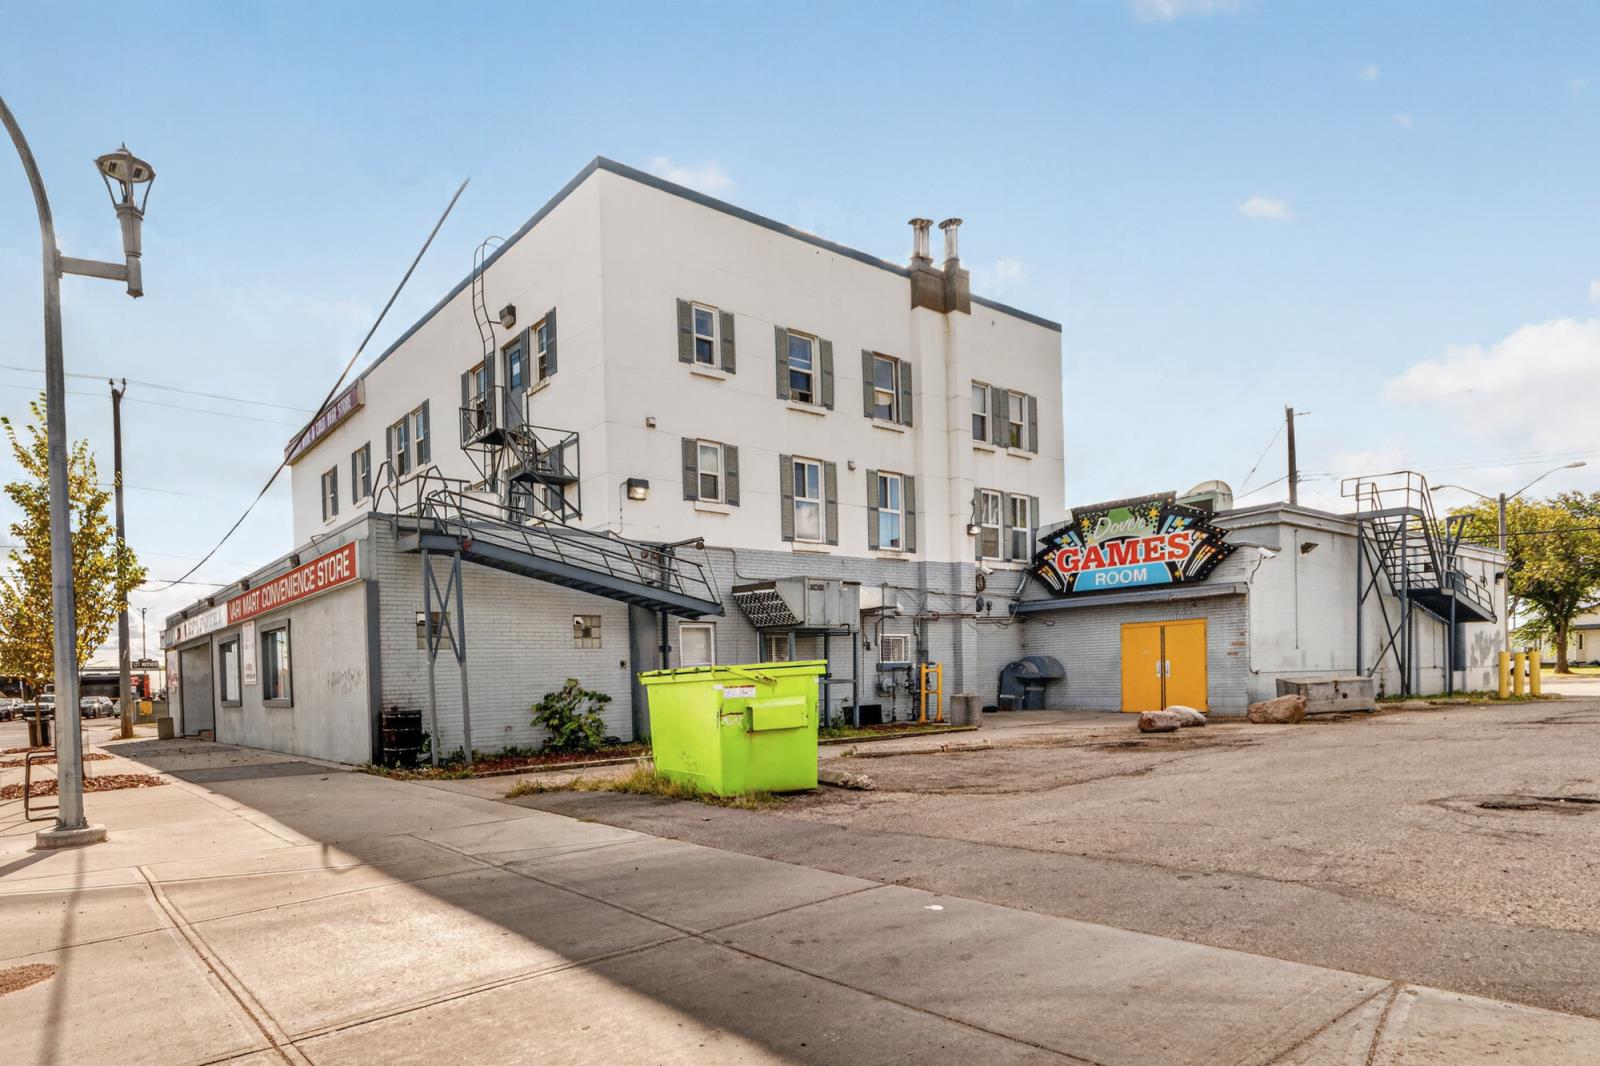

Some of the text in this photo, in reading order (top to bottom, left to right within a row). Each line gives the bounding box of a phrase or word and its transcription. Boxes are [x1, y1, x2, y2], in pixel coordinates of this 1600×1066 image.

[1055, 530, 1191, 574] GAMES
[242, 590, 260, 615] MART
[262, 566, 315, 608] CONVENIENCE
[317, 549, 350, 587] STORE
[1095, 567, 1147, 586] ROOM
